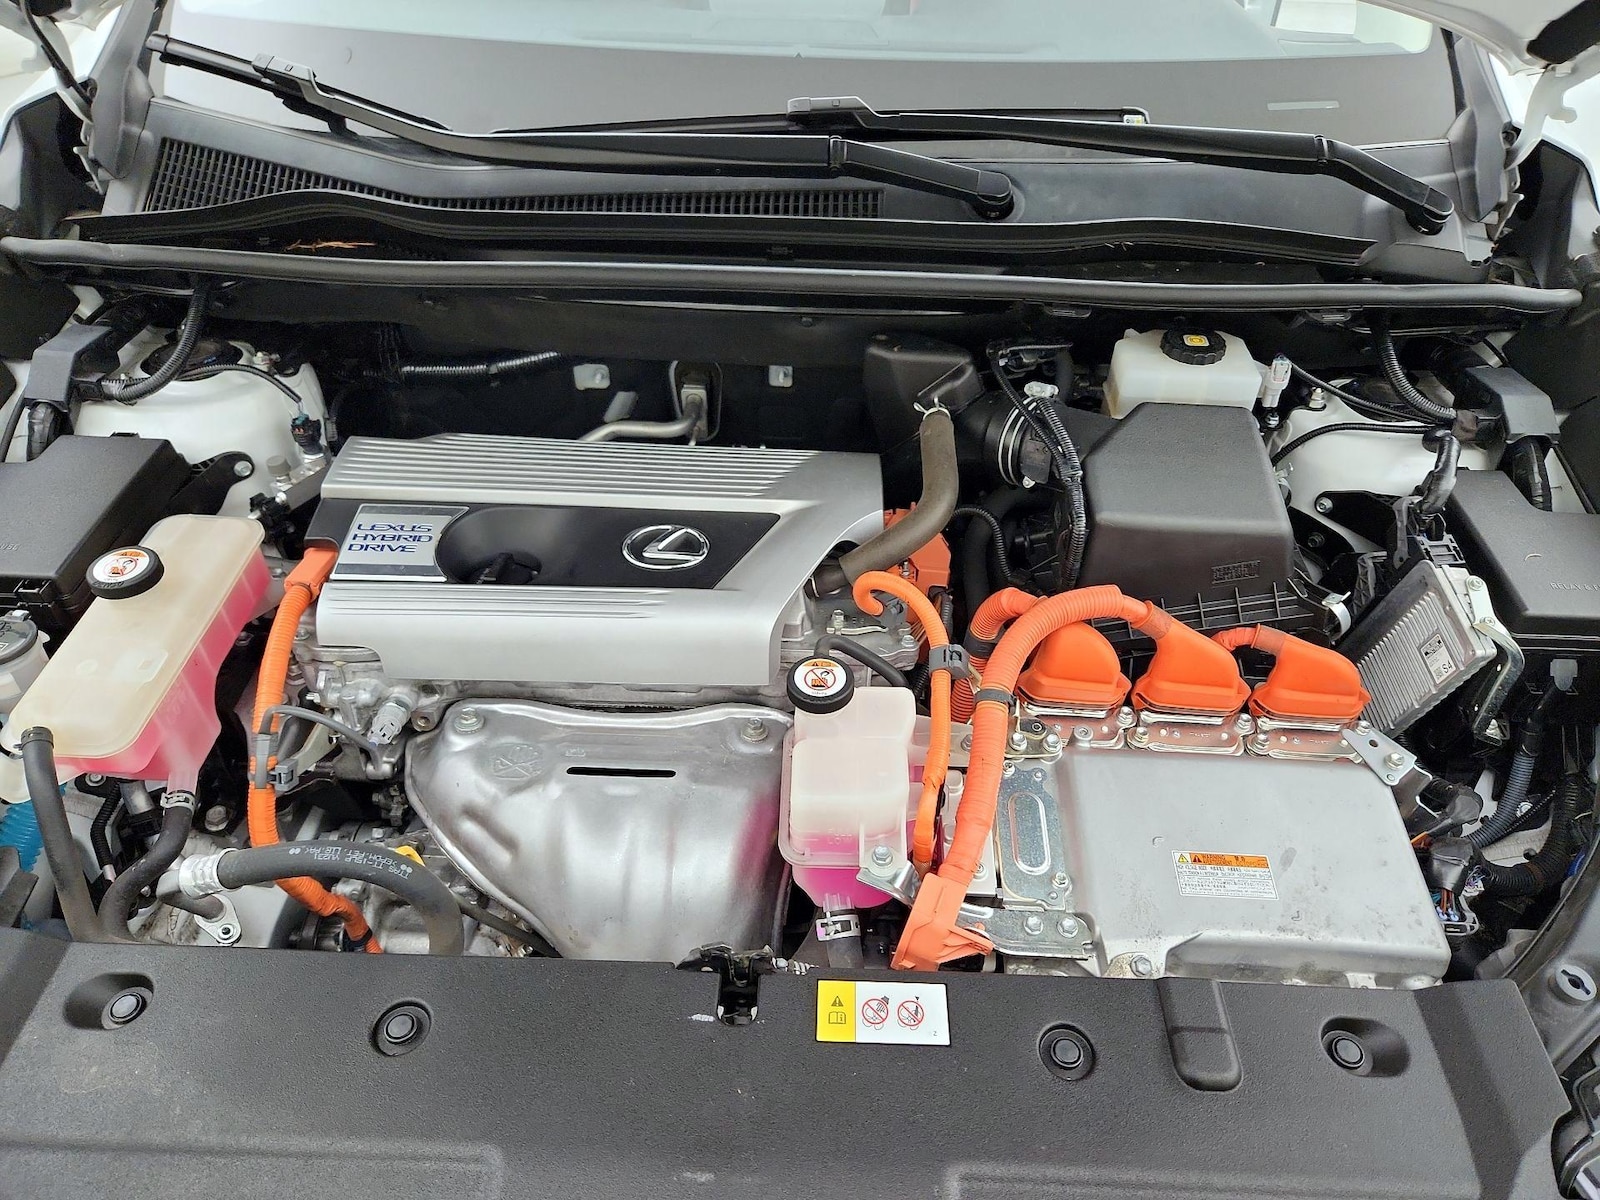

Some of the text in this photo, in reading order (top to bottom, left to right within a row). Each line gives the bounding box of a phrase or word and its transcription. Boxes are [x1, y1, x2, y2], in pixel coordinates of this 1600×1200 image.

[357, 523, 433, 533] LEXUS
[352, 533, 433, 543] HYBRID
[348, 543, 418, 553] DRIVE
